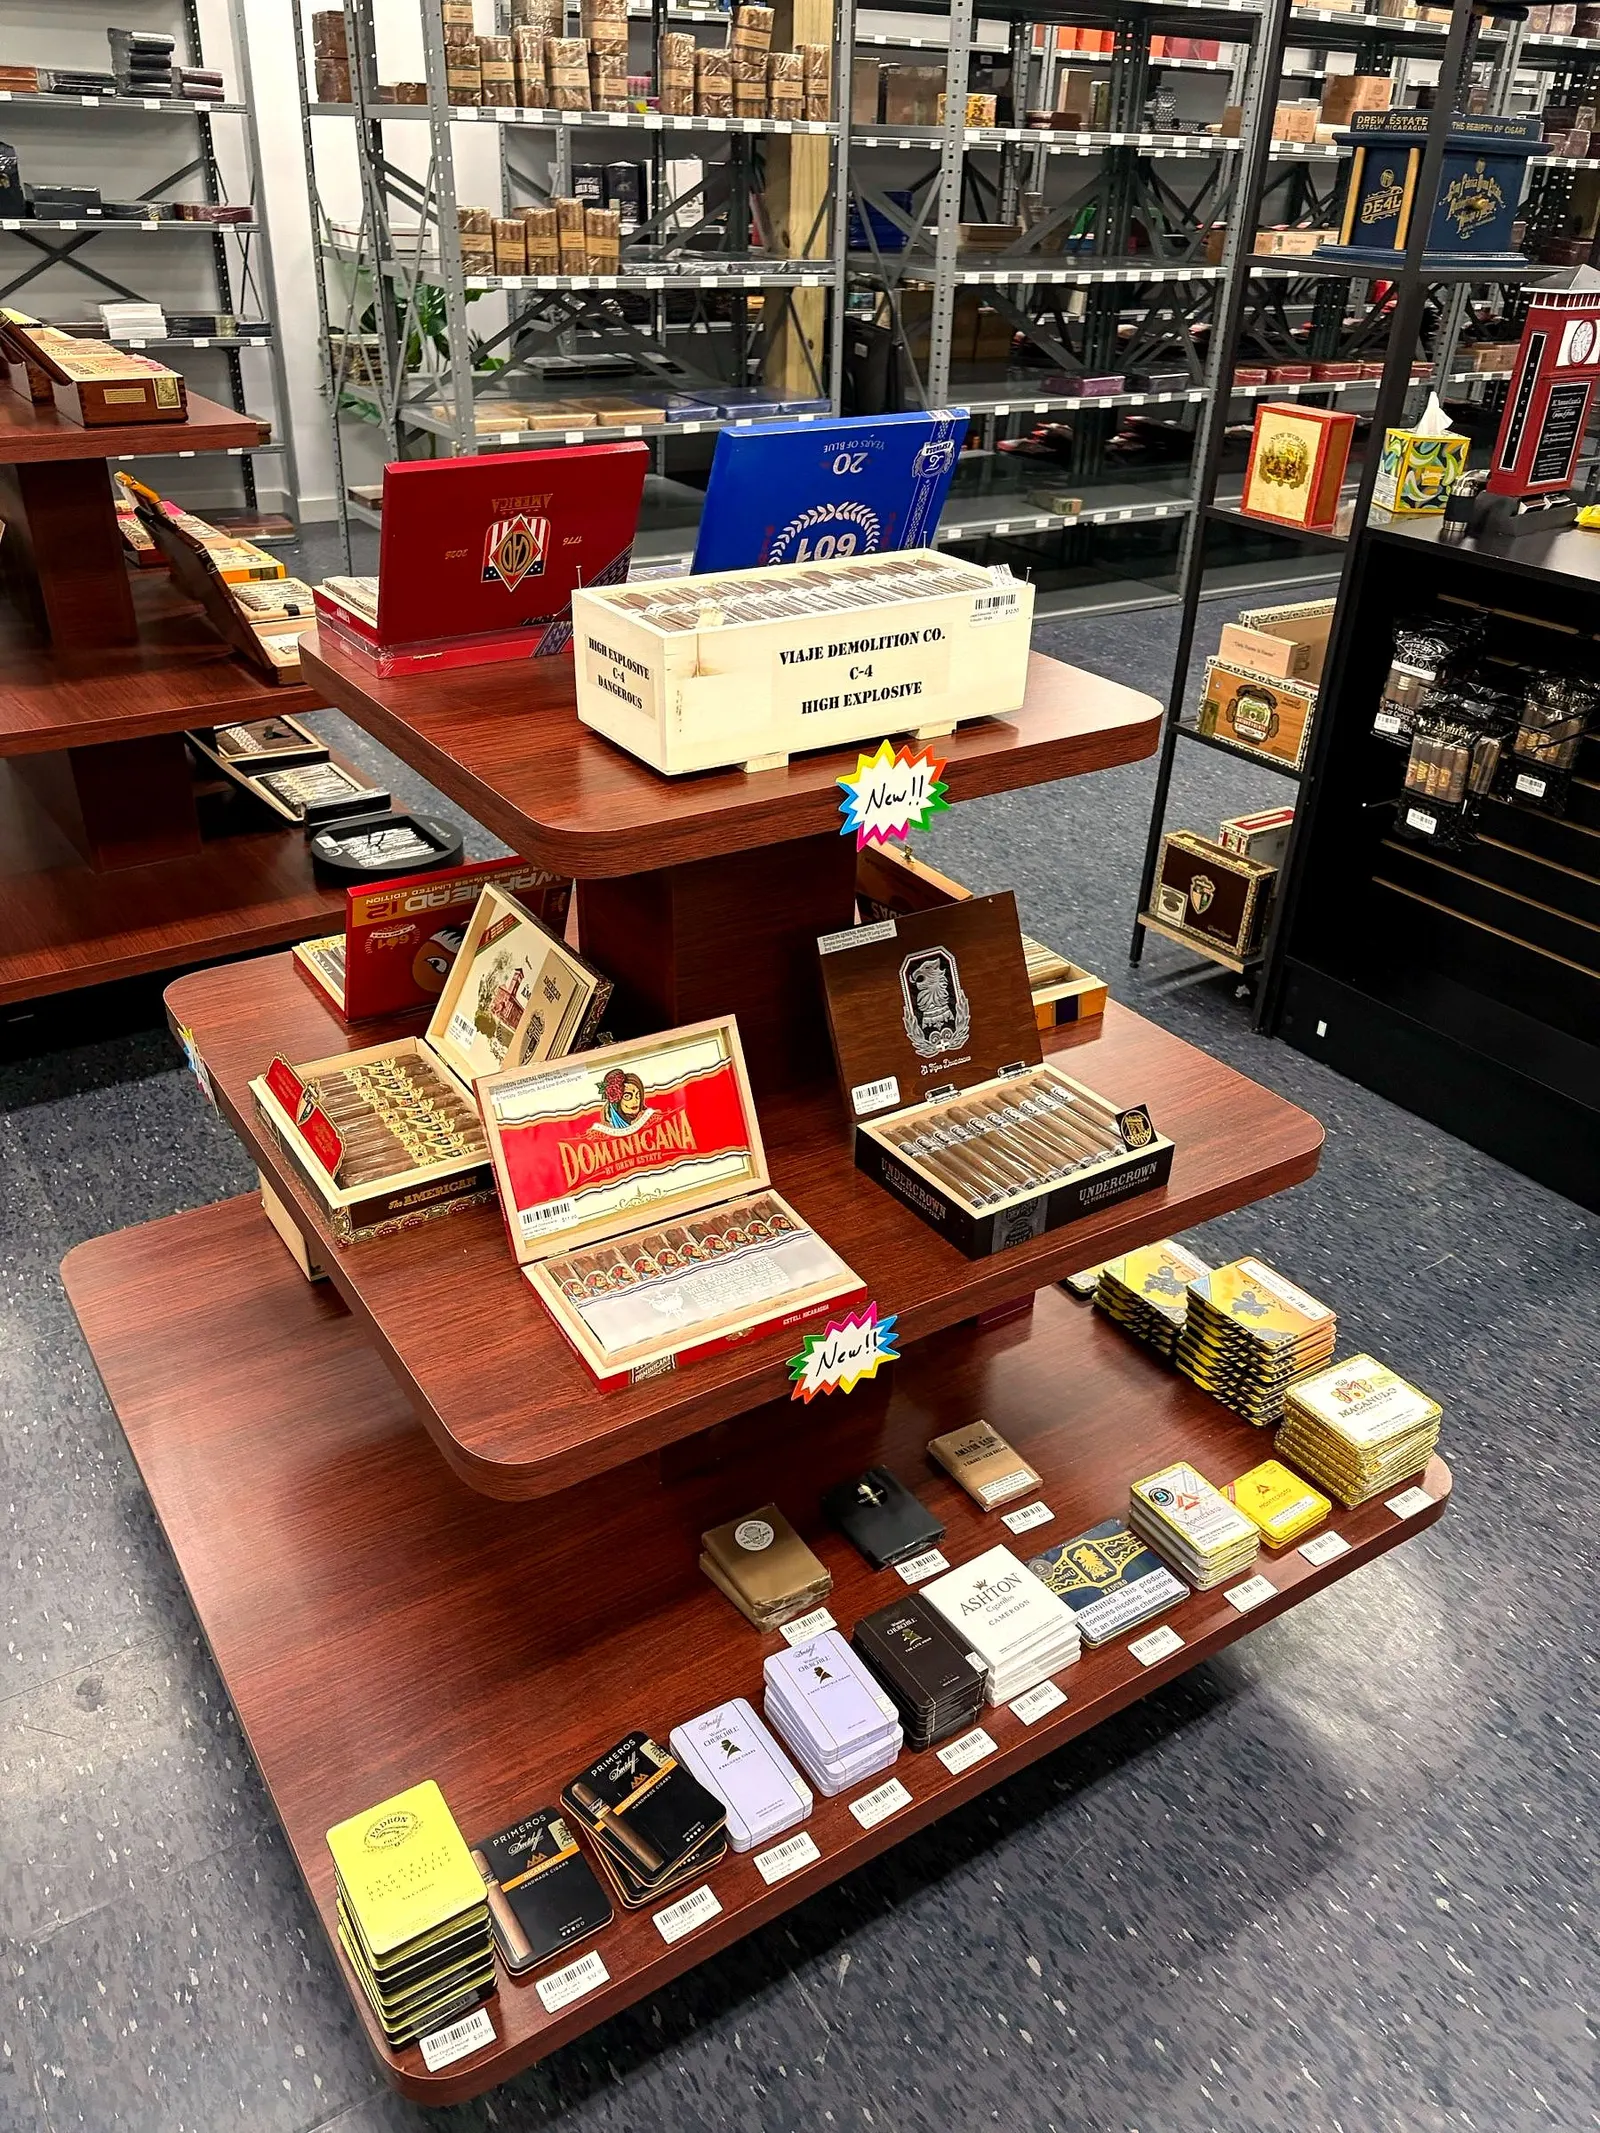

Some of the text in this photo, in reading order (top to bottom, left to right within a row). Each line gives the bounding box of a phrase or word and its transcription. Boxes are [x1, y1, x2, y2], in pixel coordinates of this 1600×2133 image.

[1357, 116, 1429, 126] DREW ESTATE
[1452, 121, 1527, 135] THE REBIRTH OF CIGARS
[823, 438, 885, 453] YEARS OF BLUE
[832, 451, 869, 476] 20
[490, 493, 554, 513] AMERICA
[562, 535, 583, 547] 1776
[588, 636, 651, 681] HIGH EXPLOSIVE
[779, 628, 946, 665] VIAJE DEMOLITION CO.
[612, 667, 626, 684] C-4
[849, 664, 874, 681] C-4
[597, 674, 643, 710] DANGEROUS
[801, 681, 923, 715] HIGH EXPLOSIVE
[865, 775, 924, 815] New!!
[366, 891, 408, 905] EDITION
[411, 884, 451, 896] LIMITED
[366, 901, 398, 920] 12
[557, 1109, 698, 1189] DOMINICANA
[605, 1152, 662, 1175] BY DREW ESTATE
[387, 1175, 477, 1210] The AMERICAN
[881, 1158, 947, 1220] UNDERCROWN
[1078, 1161, 1158, 1201] UNDERCROWN
[802, 1304, 830, 1320] NICARAGUA
[814, 1329, 879, 1379] New!!
[1258, 1488, 1292, 1509] MONTECRISTO
[960, 1572, 1023, 1617] ASHTON
[1078, 1570, 1167, 1621] WARNING: This product
[1101, 1579, 1129, 1595] MADURO
[985, 1594, 1015, 1613] Cigarillos
[988, 1599, 1031, 1626] CAMEROON
[1085, 1578, 1174, 1627] contains nicotine. Nicotine
[1091, 1589, 1173, 1634] is an addictive chemical.
[886, 1617, 917, 1636] CHURCHILL
[798, 1655, 831, 1673] CHURCHILL
[703, 1725, 740, 1747] CHURCHILL
[591, 1738, 637, 1777] PRIMEROS
[632, 1775, 672, 1810] HANDMADE CIGARS
[370, 1816, 409, 1839] PADRON
[492, 1814, 547, 1847] PRIMEROS
[520, 1860, 569, 1890] HANDMADE CIGARS
[523, 1858, 558, 1880] NICARAGUA
